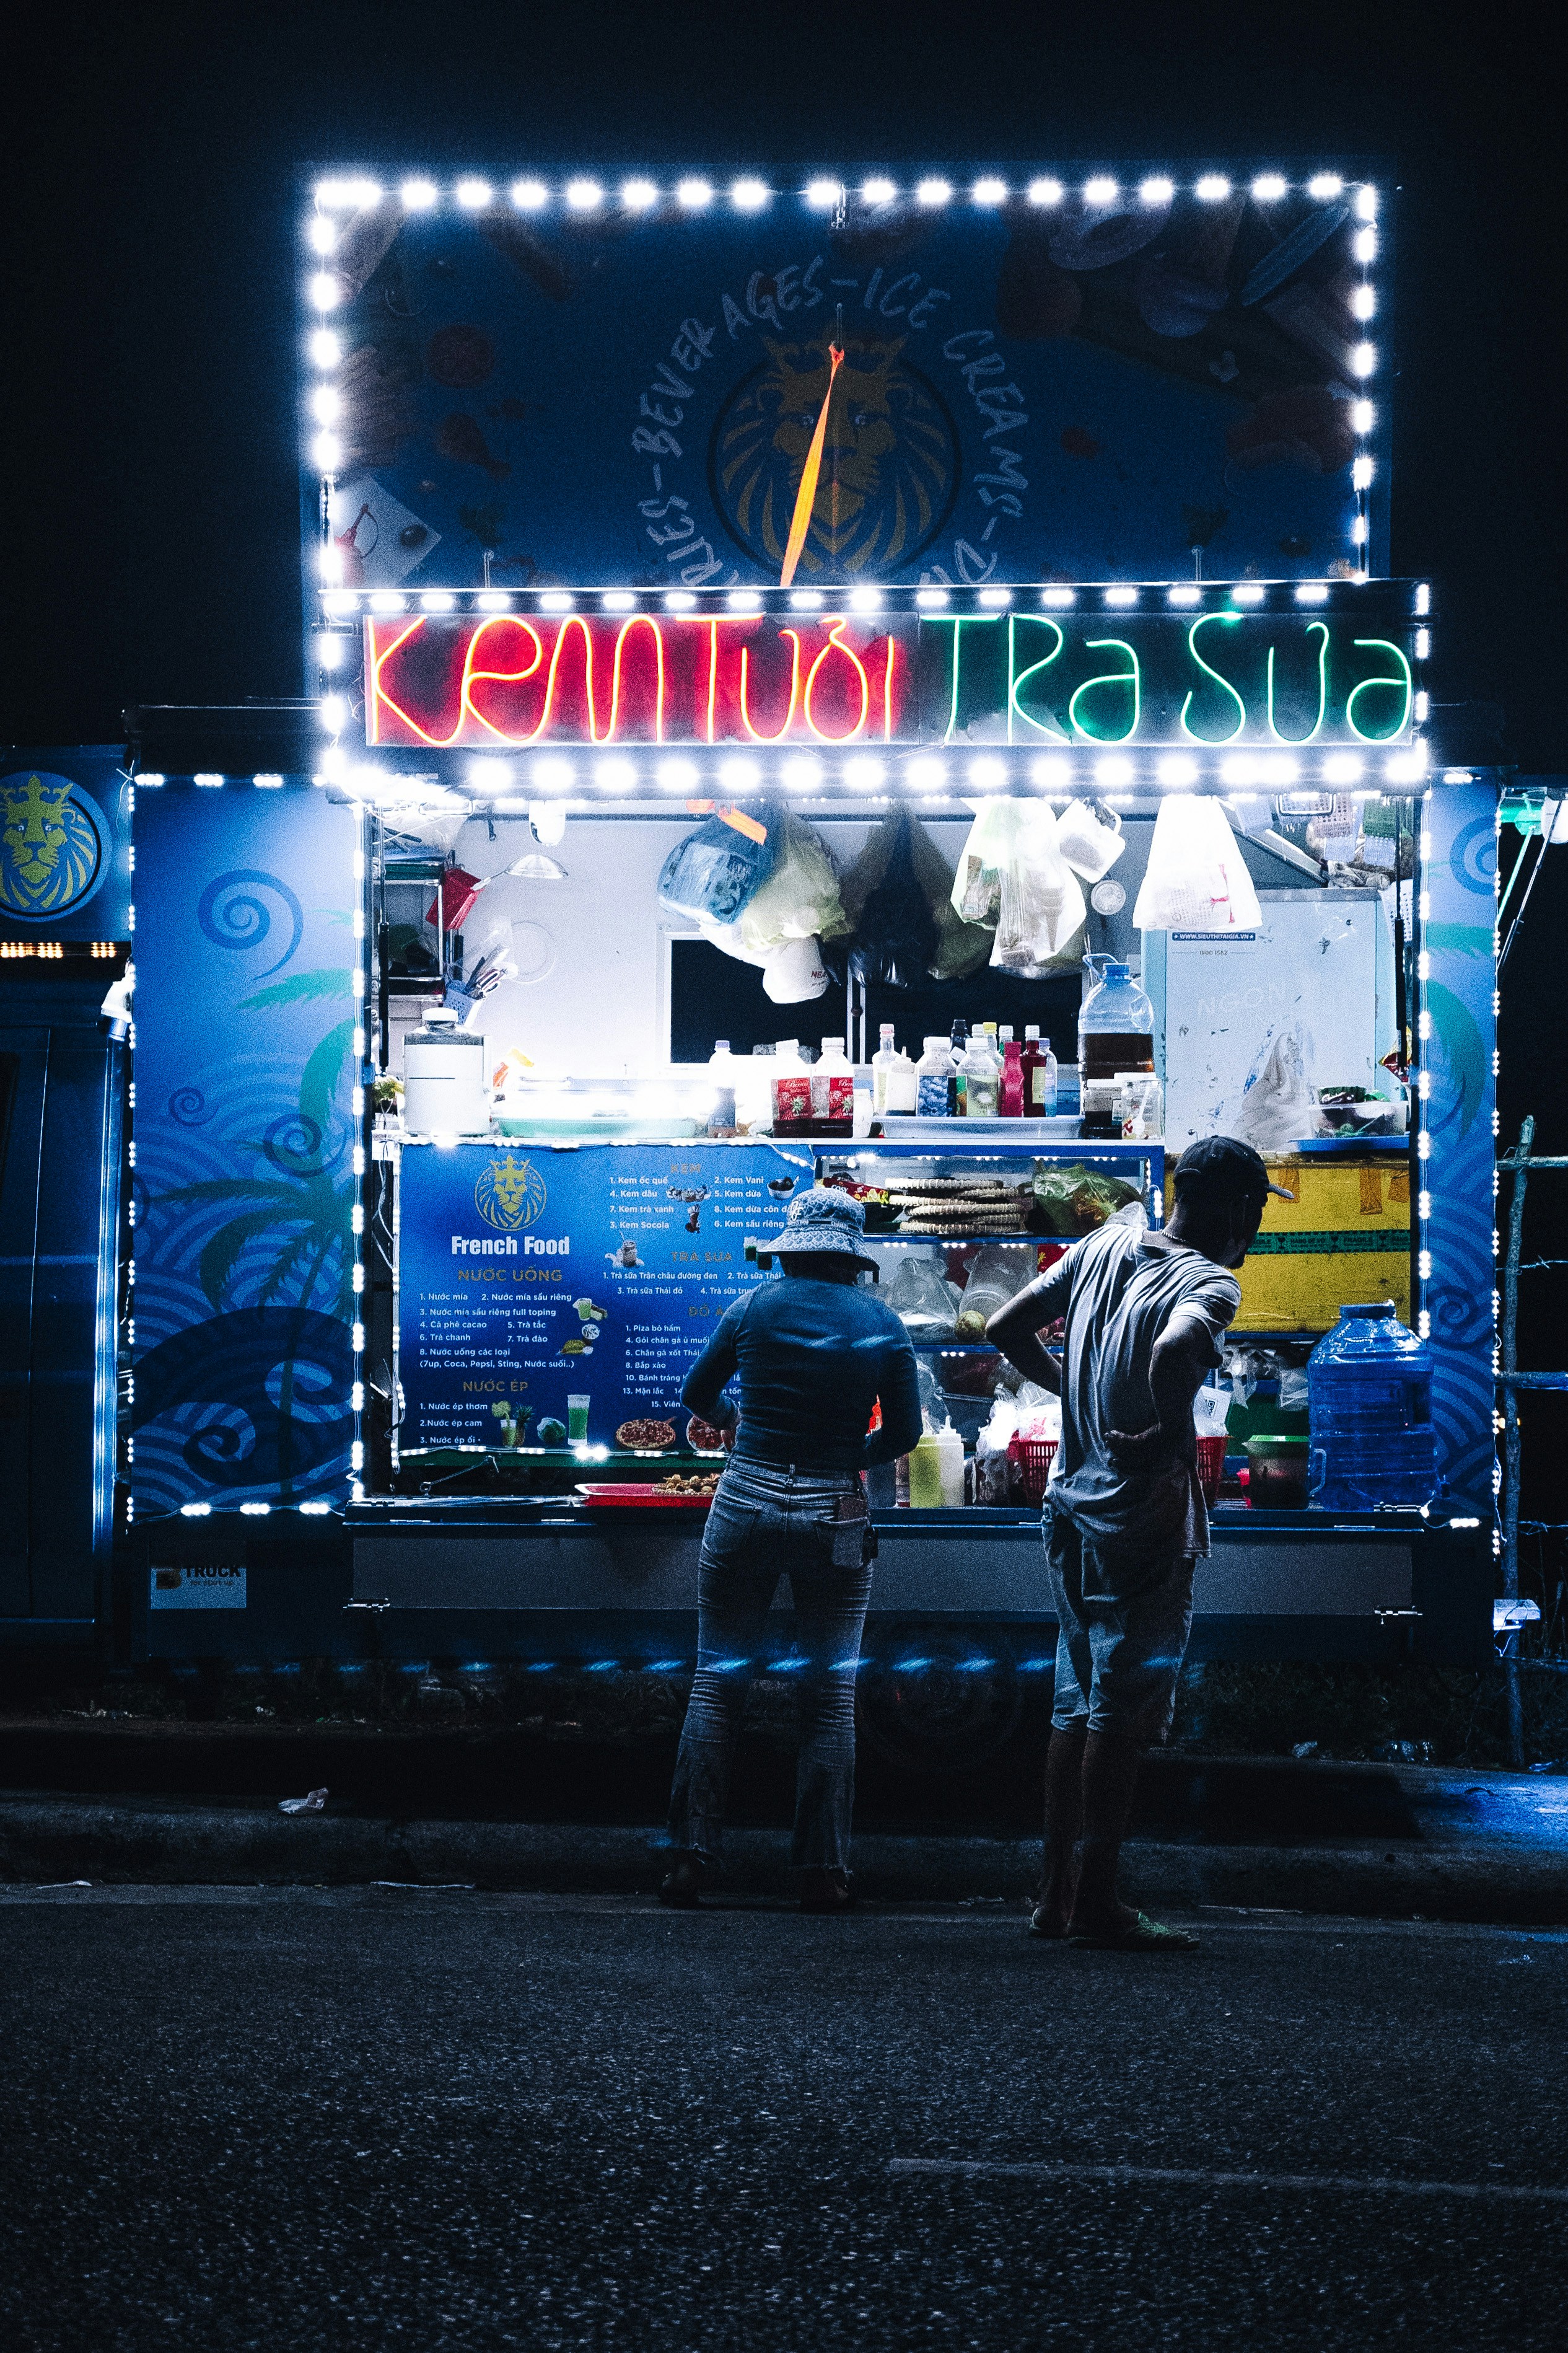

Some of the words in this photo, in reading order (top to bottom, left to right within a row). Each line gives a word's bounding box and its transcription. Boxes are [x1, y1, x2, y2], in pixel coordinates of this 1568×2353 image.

[862, 266, 951, 329] ICE
[943, 329, 1030, 518] CREAMS
[637, 494, 740, 586] RIES
[670, 1163, 701, 1173] KEM
[452, 1236, 517, 1255] French
[524, 1236, 570, 1255] Food
[458, 1265, 507, 1282] NƯỚC
[512, 1264, 563, 1282] UỐNG
[428, 1293, 450, 1301] Nước
[491, 1293, 514, 1301] Nước
[550, 1293, 572, 1302] riêng
[430, 1308, 452, 1316] Nước
[488, 1308, 510, 1317] riêng
[528, 1309, 556, 1317] toping
[444, 1321, 460, 1329] phê
[495, 1348, 510, 1358] loại
[419, 1360, 442, 1368] (7up,
[444, 1360, 468, 1368] Coca,
[470, 1360, 495, 1368] Pepsi,
[497, 1360, 522, 1368] Sting,
[524, 1360, 546, 1368] Nước
[463, 1378, 506, 1392] NƯỚC
[453, 1403, 463, 1411] ép
[452, 1419, 462, 1428] ép
[454, 1436, 465, 1445] ép
